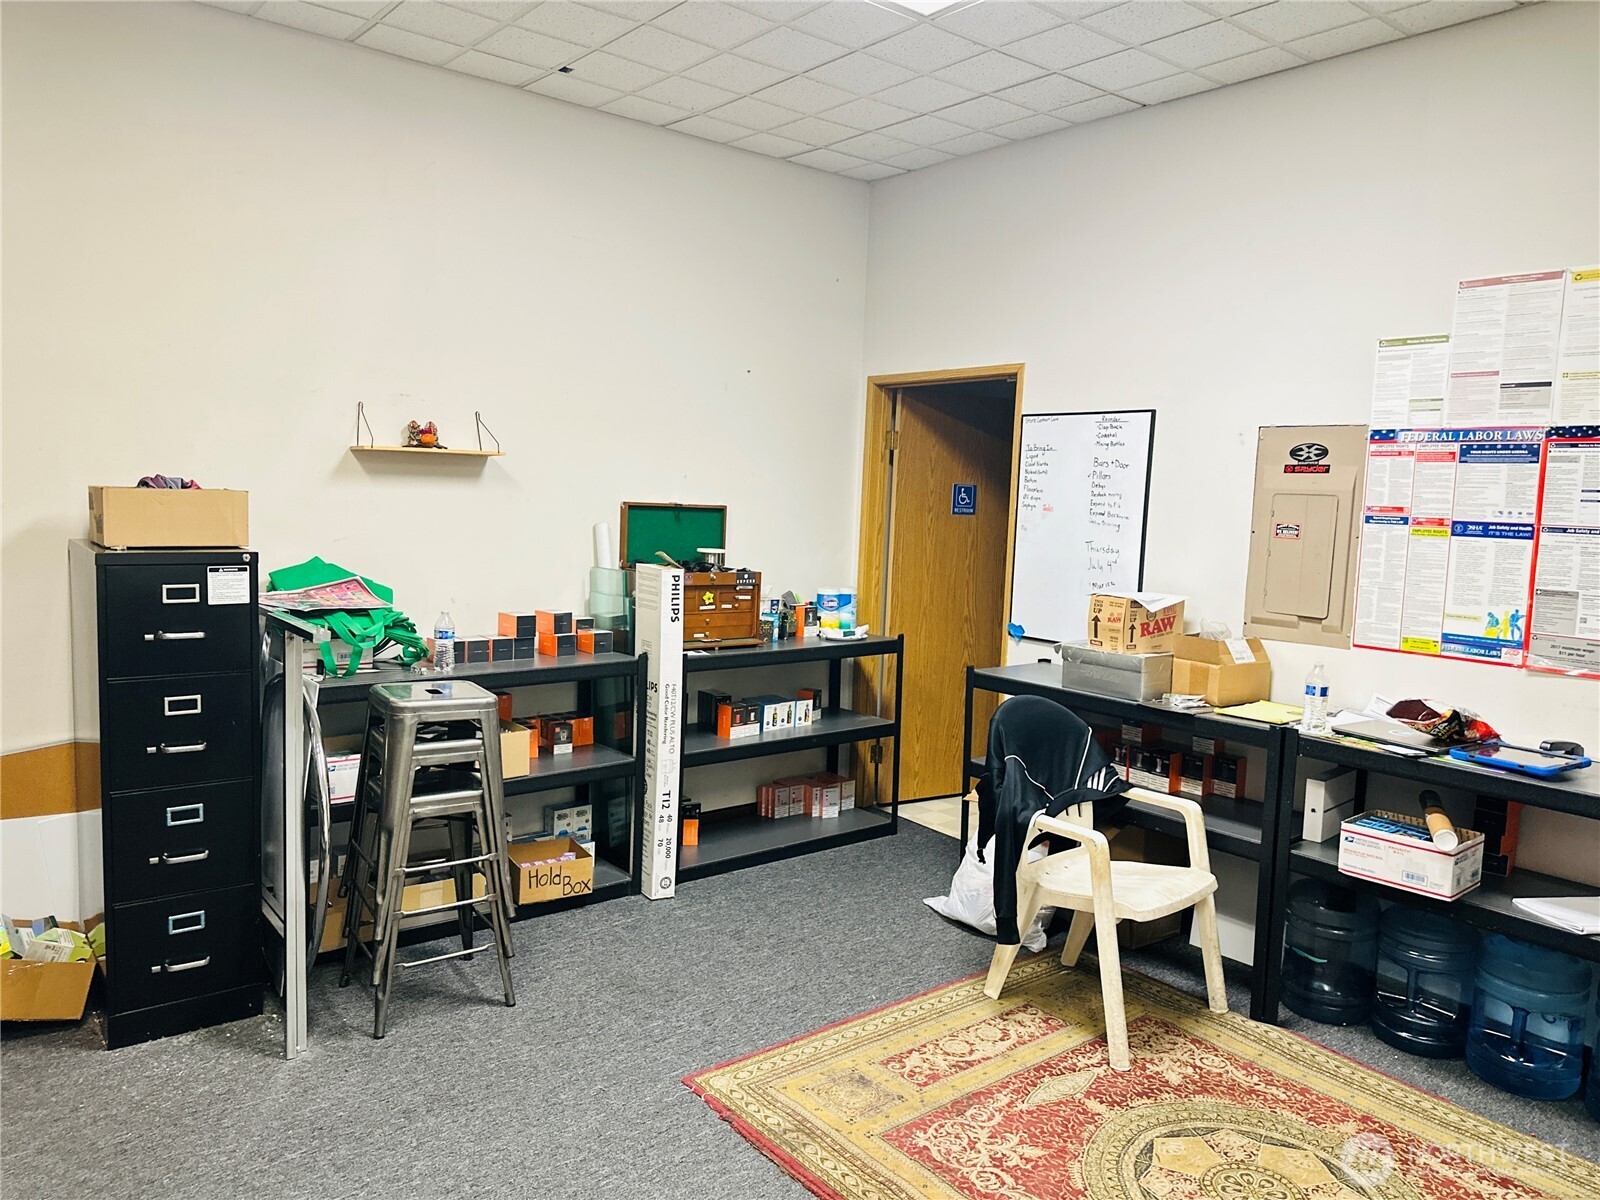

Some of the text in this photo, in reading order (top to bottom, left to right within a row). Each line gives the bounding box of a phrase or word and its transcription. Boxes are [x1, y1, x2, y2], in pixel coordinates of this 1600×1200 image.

[1402, 430, 1544, 443] FEDERAL LABOR LAWS
[1115, 459, 1130, 469] Door
[1092, 470, 1111, 480] Pillars
[1085, 540, 1120, 559] Thursday
[1087, 556, 1104, 572] July
[671, 574, 681, 623] PHILIPS
[1107, 616, 1122, 624] RAW
[1140, 615, 1177, 638] RAW
[1466, 647, 1485, 655] LABOR
[1485, 649, 1501, 657] LAWS
[666, 813, 673, 823] 40
[657, 814, 665, 848] 48 70
[528, 865, 591, 896] Hold Box
